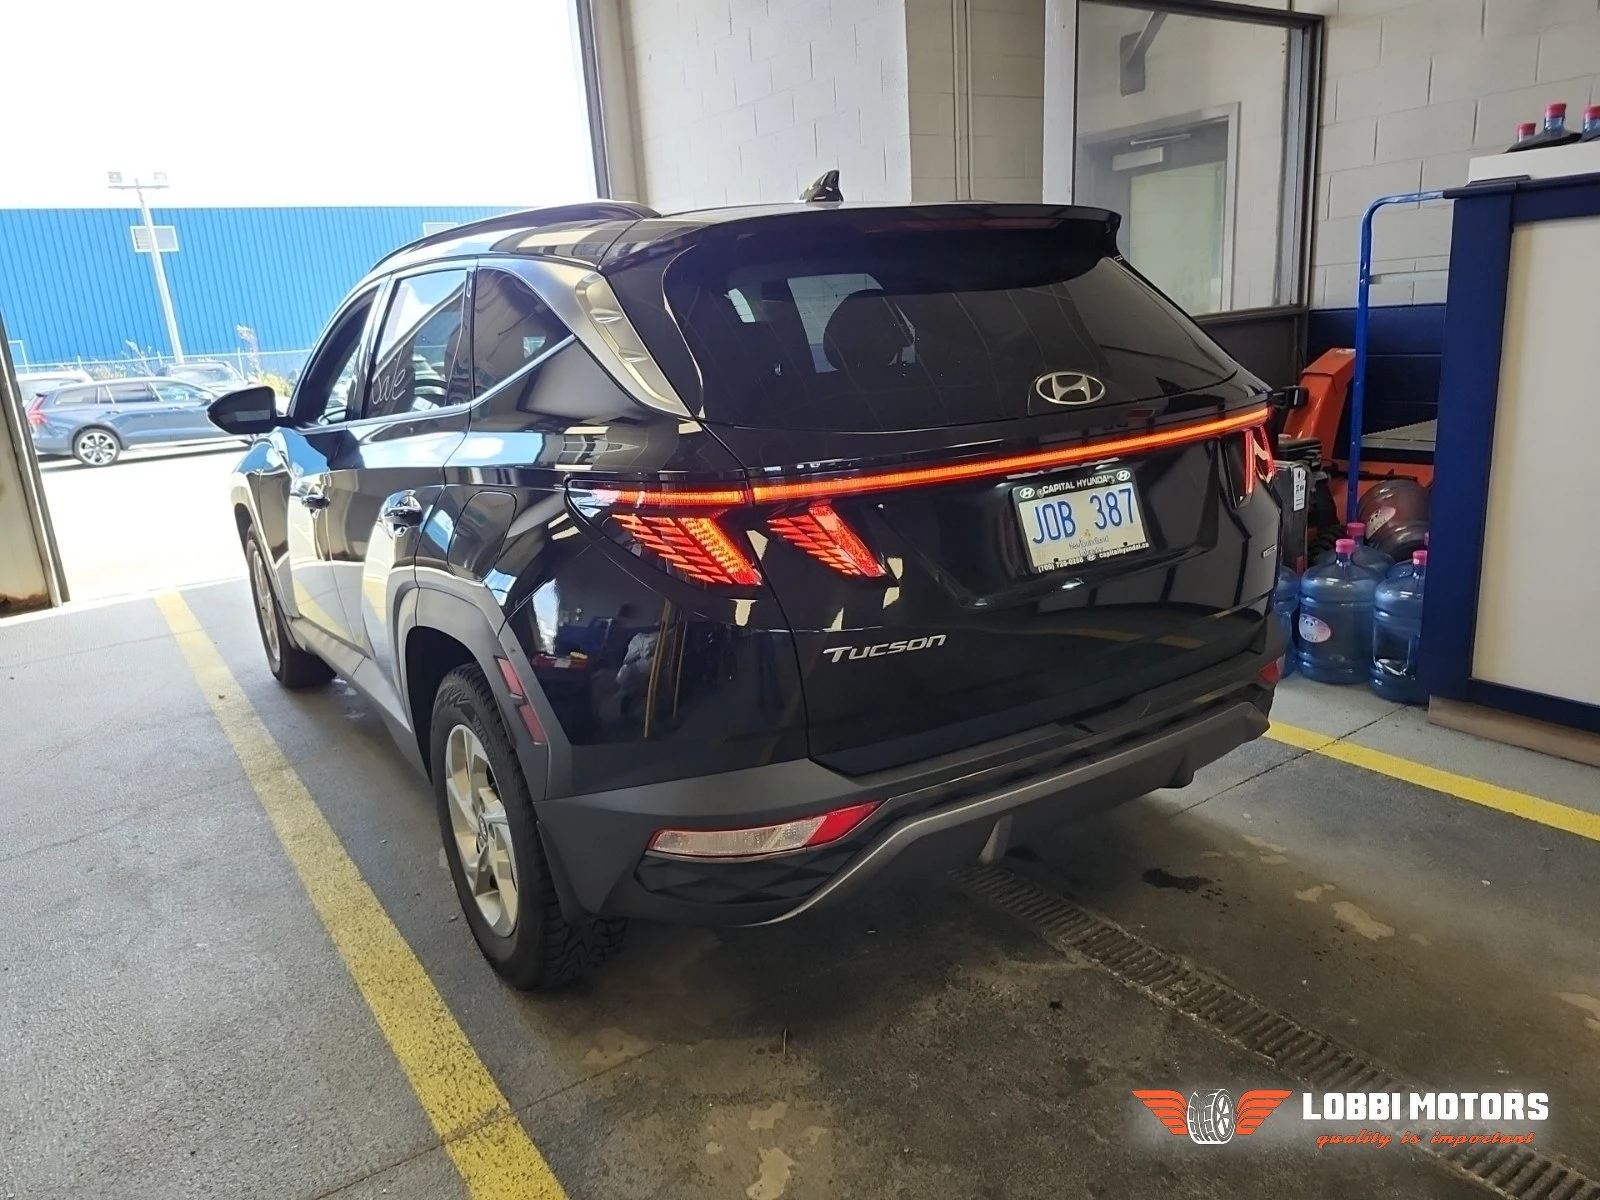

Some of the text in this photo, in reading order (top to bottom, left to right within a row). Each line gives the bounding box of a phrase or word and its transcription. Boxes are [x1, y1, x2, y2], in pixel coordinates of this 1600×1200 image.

[1041, 481, 1075, 495] CAPITAL
[1032, 487, 1134, 544] JOB 387
